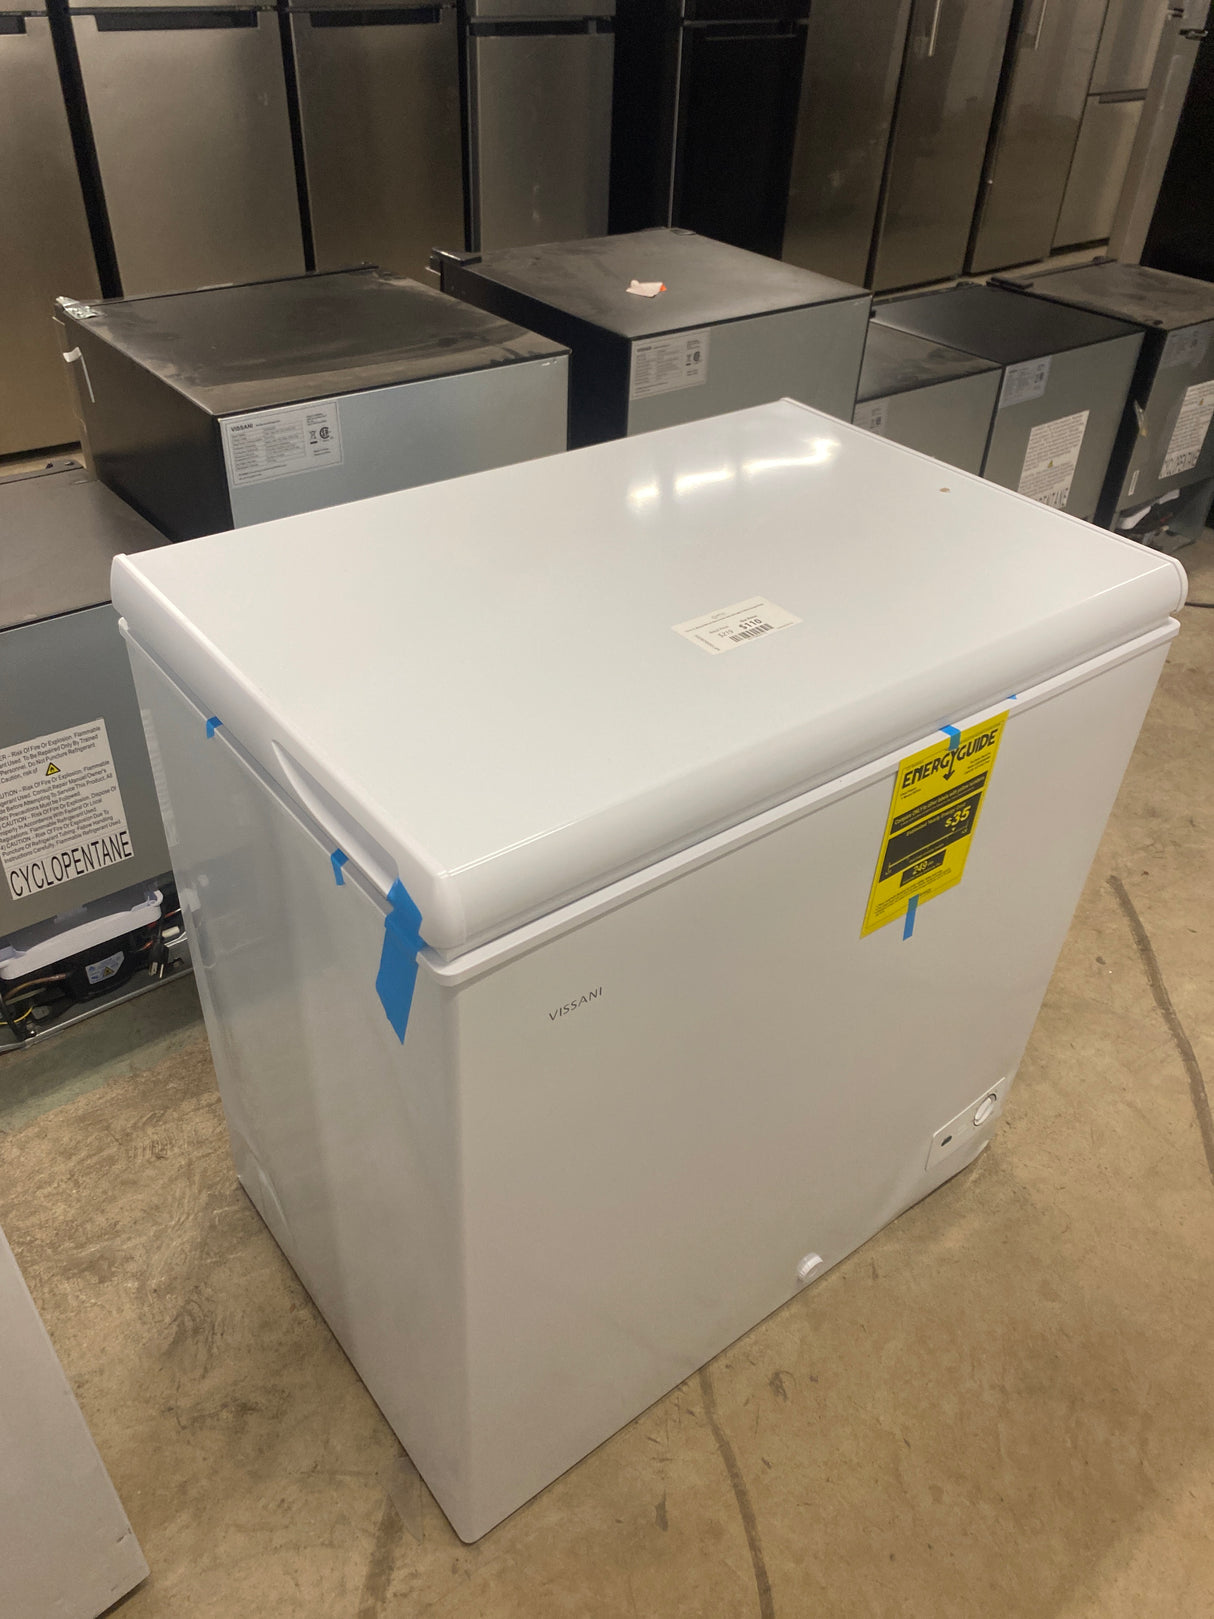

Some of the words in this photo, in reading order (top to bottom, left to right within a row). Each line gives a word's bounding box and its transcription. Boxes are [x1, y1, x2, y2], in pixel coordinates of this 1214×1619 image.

[738, 618, 762, 629] $110
[60, 741, 72, 749] Only
[902, 728, 998, 788] ENERGYGUIDE
[1, 816, 26, 828] CAUTION
[31, 810, 41, 818] Risk
[945, 805, 971, 828] $35
[6, 836, 31, 848] CAUTION
[10, 831, 132, 897] CYCLOPENTANE
[549, 986, 602, 1020] VISSANI
